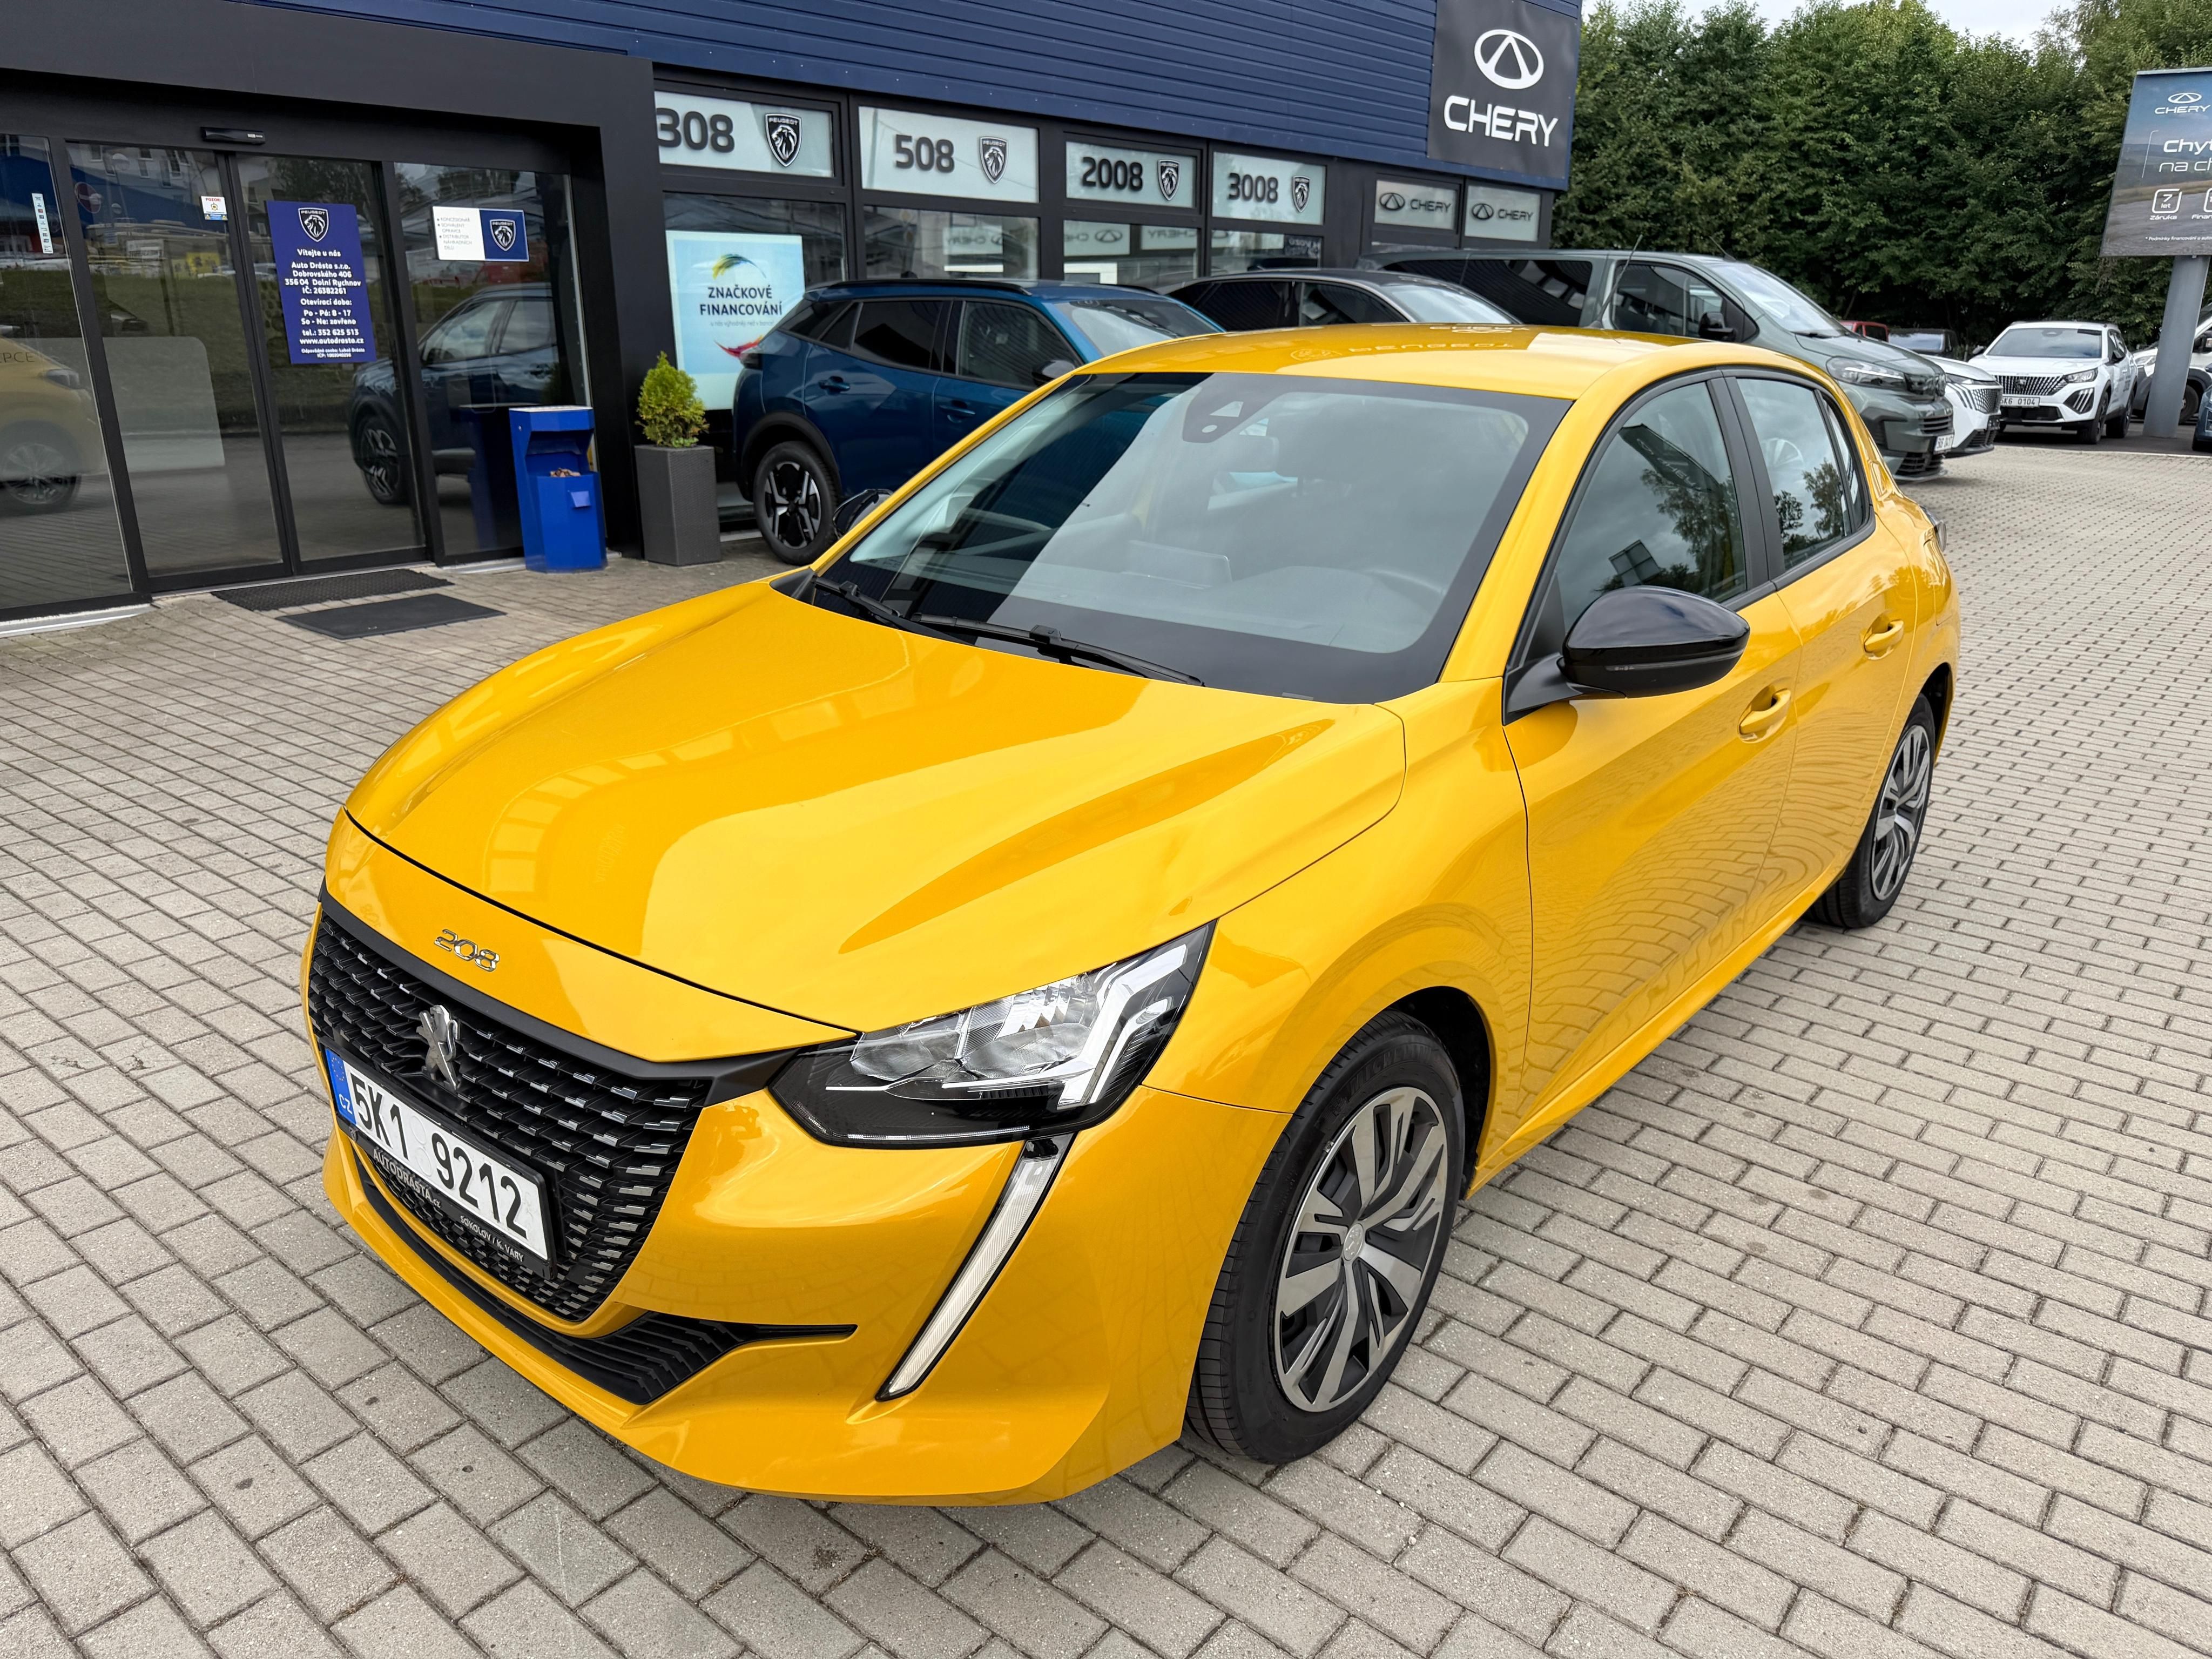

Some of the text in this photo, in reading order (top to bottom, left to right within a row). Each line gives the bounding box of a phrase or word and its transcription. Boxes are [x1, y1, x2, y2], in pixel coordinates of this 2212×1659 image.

[2155, 105, 2211, 114] CHERY
[657, 107, 735, 153] 308
[768, 117, 799, 125] PEUGEOT
[1444, 95, 1559, 147] CHERY
[895, 134, 955, 173] 508
[1082, 157, 1143, 192] 2008
[2159, 162, 2188, 172] na
[1228, 173, 1279, 203] 3008
[1410, 199, 1452, 213] CHERY
[2163, 194, 2173, 203] 7
[1498, 208, 1534, 221] CHERY
[297, 248, 321, 257] Vítejte
[708, 285, 773, 299] ZNAČKOVÉ
[700, 301, 783, 315] FINANCOVÁNÍ
[434, 928, 500, 972] 208
[339, 1092, 353, 1116] CZ
[350, 1073, 528, 1240] 5K1 9212
[460, 1215, 491, 1241] SOKOLOV
[496, 1238, 504, 1251] K.
[504, 1243, 524, 1263] VARY
